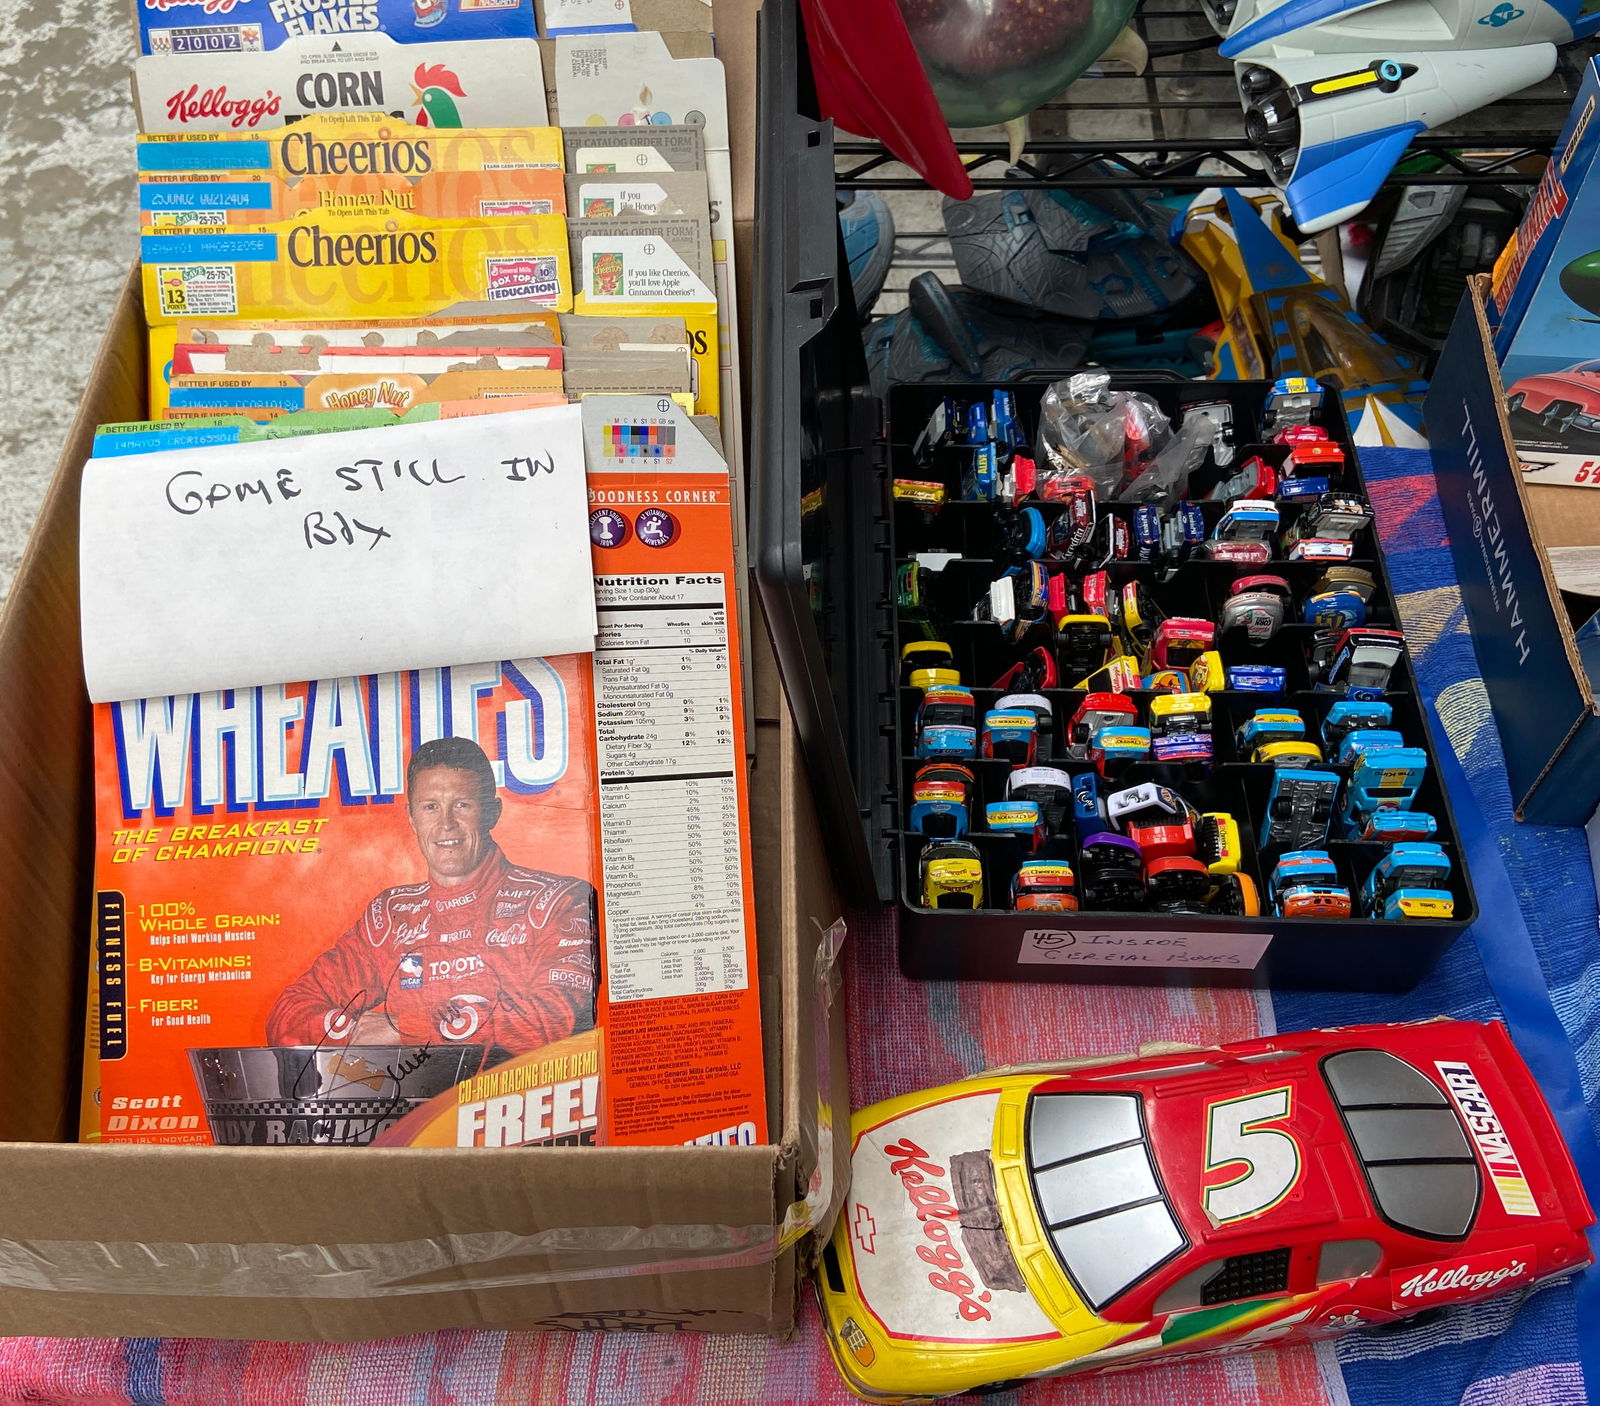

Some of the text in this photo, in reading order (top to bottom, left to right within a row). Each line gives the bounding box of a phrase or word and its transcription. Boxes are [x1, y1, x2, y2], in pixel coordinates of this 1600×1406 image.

[284, 5, 380, 37] FLAKES
[173, 35, 240, 51] 2002
[296, 71, 385, 109] CORN
[166, 84, 282, 128] Kellogg's
[584, 136, 692, 148] CATALOG ORDER FORM
[281, 126, 432, 176] Cheerios
[318, 189, 417, 210] Honey Nut
[620, 191, 641, 201] If you
[635, 202, 657, 212] Honey
[287, 219, 439, 268] Cheerios
[492, 274, 537, 288] BOX TOPS
[628, 268, 691, 278] If you like Cheerios,
[496, 282, 556, 299] EDUCATION
[628, 278, 680, 288] you'll love Apple
[167, 290, 186, 304] 13
[628, 288, 663, 297] Cinnamon
[326, 387, 376, 408] Honey
[378, 381, 410, 408] Nut
[105, 426, 138, 434] BETTER
[148, 424, 172, 432] USED
[173, 422, 185, 430] BY
[335, 457, 466, 493] STILL
[500, 448, 555, 483] IN
[1461, 400, 1531, 667] HAMMERMILL
[594, 576, 722, 587] Nutrition Facts
[629, 594, 658, 602] Container
[598, 710, 623, 718] Sodium
[113, 657, 569, 815] WHEATIES
[598, 734, 645, 742] Carbohydrate
[111, 818, 330, 847] THE BREAKFAST
[111, 837, 321, 864] OF CHAMPIONS
[138, 901, 196, 918] 100%
[445, 892, 477, 910] TARGET
[150, 931, 256, 946] Helps Fuel Working Muscles
[1032, 932, 1066, 946] 45
[428, 954, 486, 976] TOYOTA
[104, 903, 122, 1046] FITNESS FUEL
[150, 970, 252, 986] Key for Energy Metabolism
[551, 972, 591, 986] BOSCH
[151, 1014, 212, 1027] For Good Health
[458, 1050, 599, 1104] CD-ROM RACING GAME DEMO
[664, 1062, 742, 1078] General Mills Cereals, LLC
[111, 1094, 183, 1110] Scott
[456, 1075, 599, 1148] FREE!
[1450, 1066, 1514, 1169] NASCAR
[107, 1114, 200, 1132] Dixon
[1204, 1085, 1300, 1224] 5
[884, 1138, 992, 1323] Kellogg's
[1400, 1259, 1527, 1299] Kellogg's
